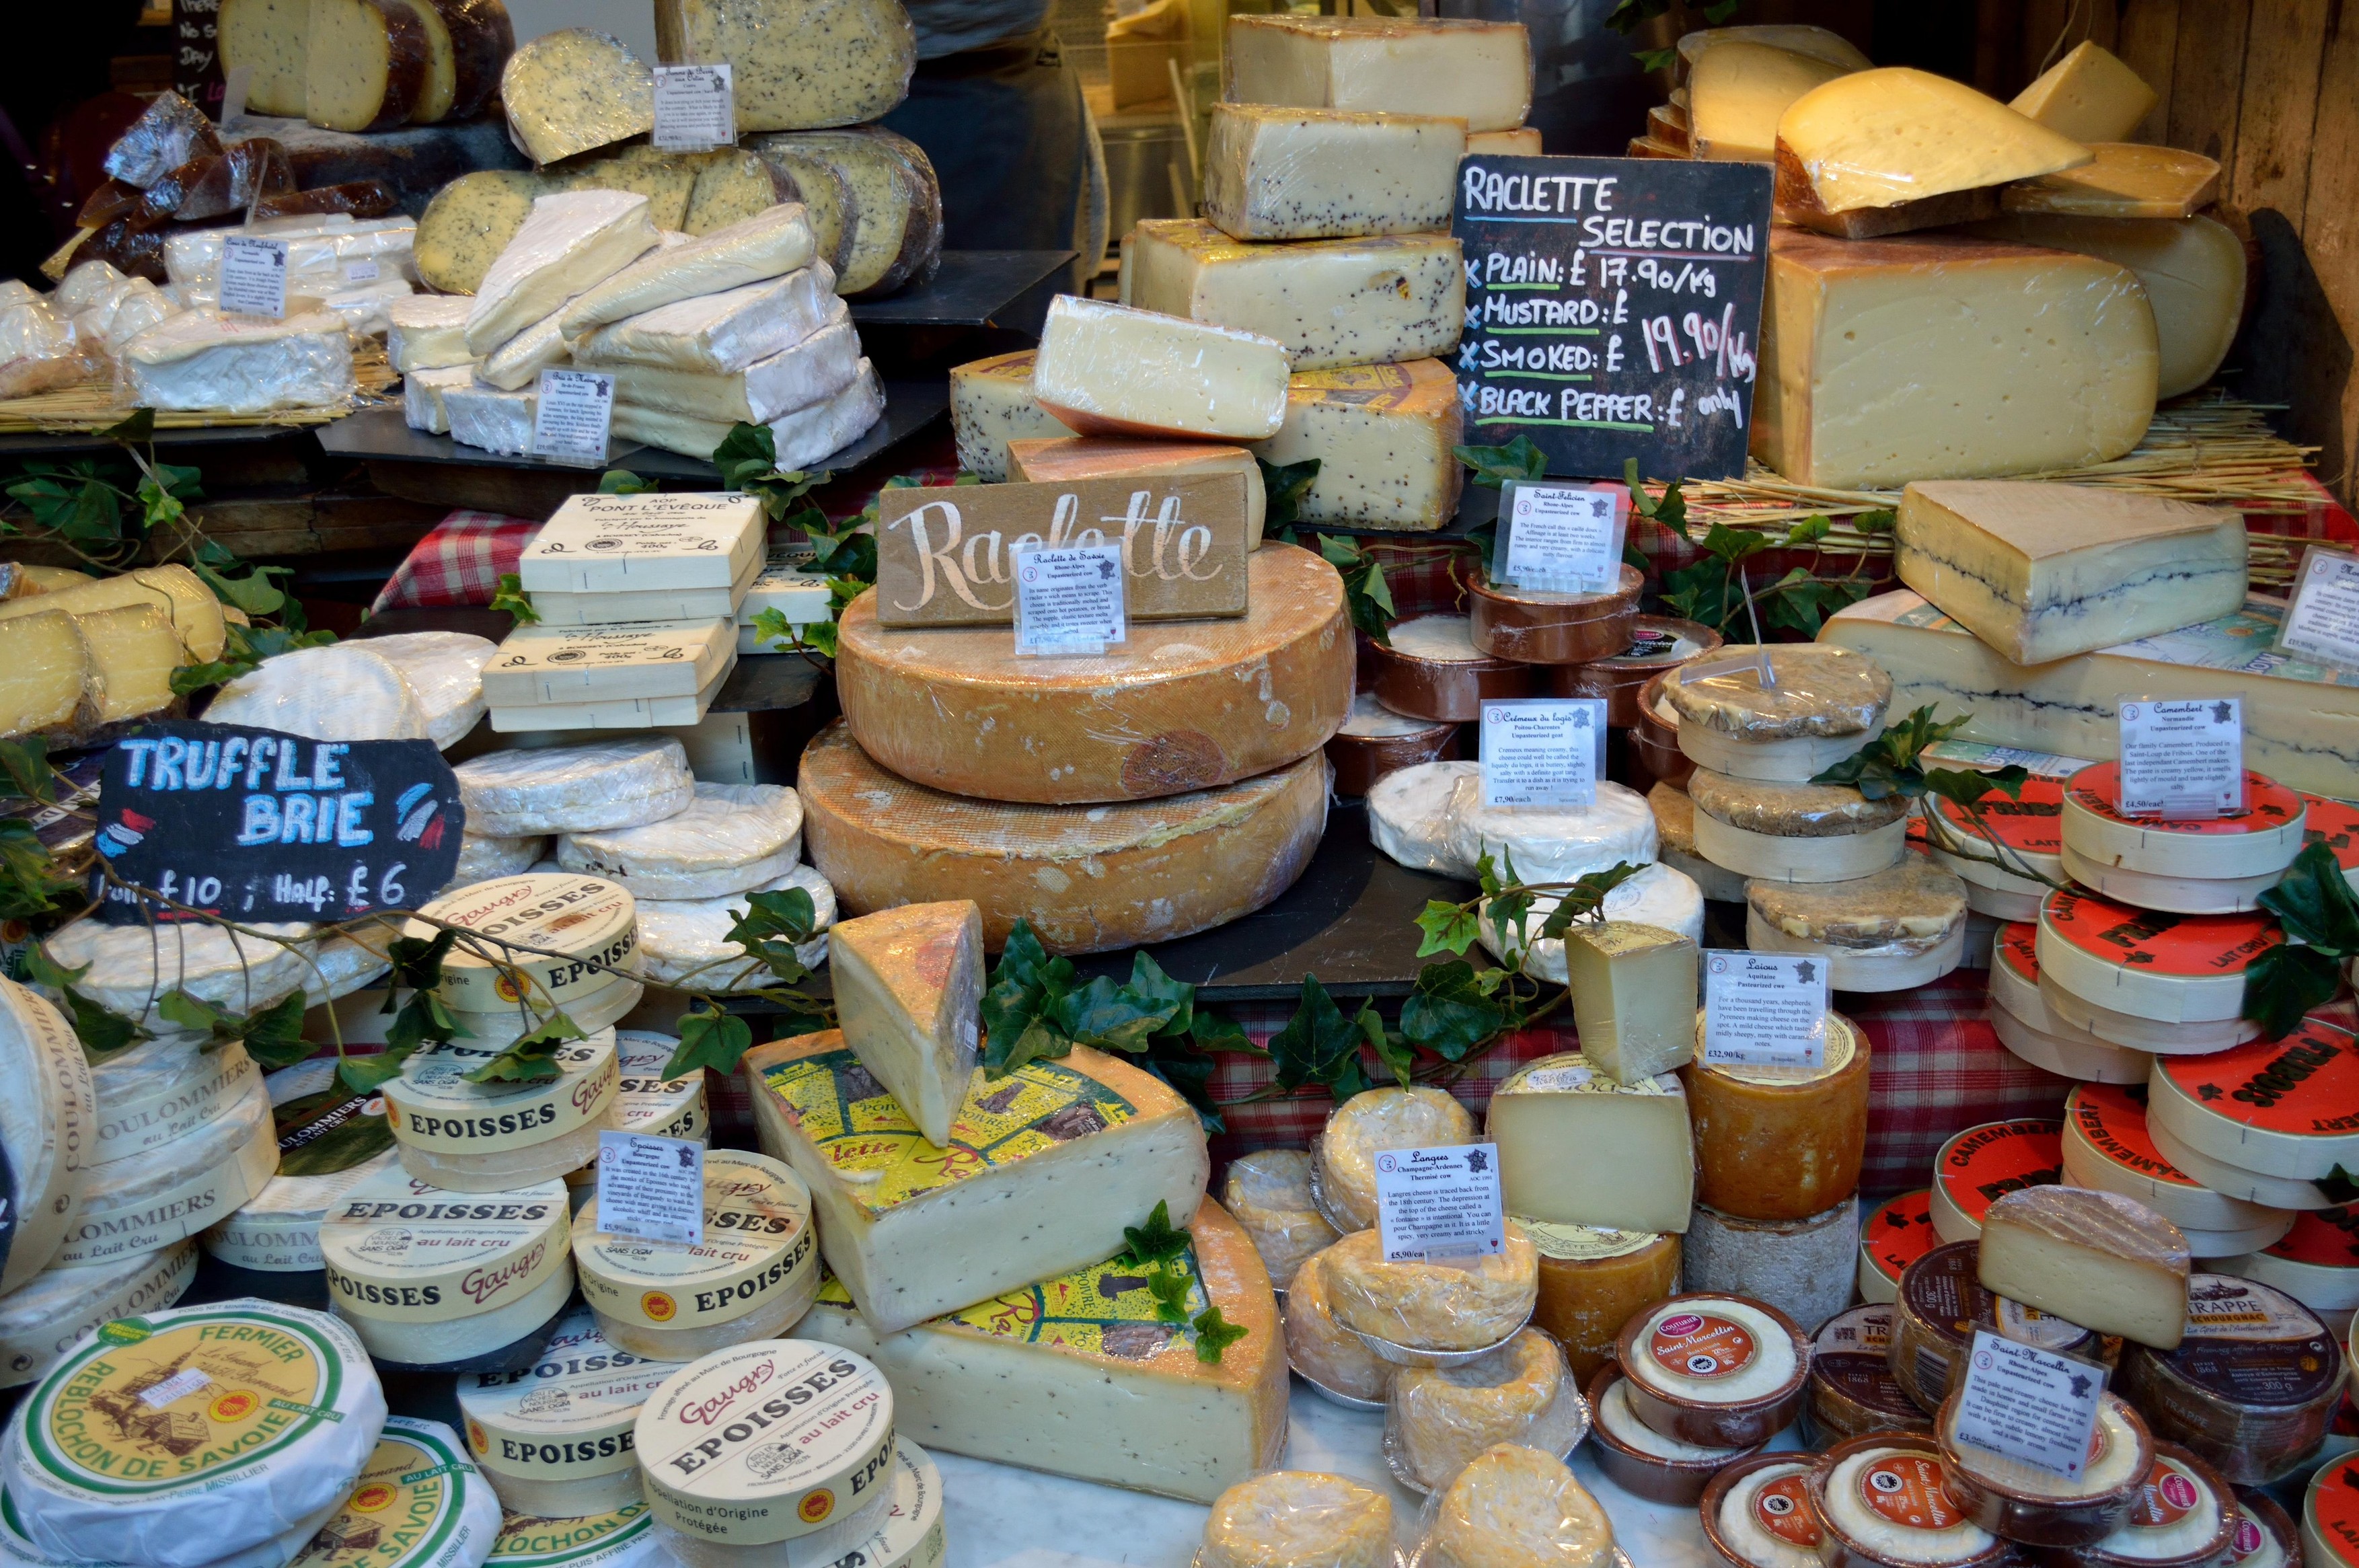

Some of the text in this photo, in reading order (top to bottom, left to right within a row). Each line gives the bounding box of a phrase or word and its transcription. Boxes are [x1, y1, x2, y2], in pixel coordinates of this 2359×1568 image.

[1464, 166, 1618, 213] RACLETTE
[1480, 388, 1550, 415] BLACK
[1698, 387, 1742, 428] only
[1034, 554, 1066, 564] Raclette
[1080, 550, 1105, 560] Savoie
[1552, 713, 1572, 724] logis
[2154, 702, 2203, 714] Camembert
[119, 735, 350, 792] TRUFFLE
[237, 790, 376, 848] BRIE
[1746, 959, 1778, 971] Laious
[1782, 999, 1811, 1007] shepherds
[295, 1116, 348, 1148] AU LAIT CRU
[409, 1103, 557, 1138] EPOISSES
[630, 1137, 663, 1152] Epoisses
[633, 1152, 660, 1160] Bourgogne
[622, 1159, 659, 1168] Unpasteurized
[1397, 1164, 1463, 1173] Champagne-Ardennes
[1411, 1151, 1449, 1165] Langres
[341, 1203, 549, 1221] EPOISSES
[416, 1237, 511, 1248] au lait cru
[687, 1246, 751, 1262] lait cru
[63, 1251, 85, 1262] au
[695, 1230, 811, 1312] EPOISSES
[1660, 1316, 1698, 1331] COUTURIER
[199, 1325, 305, 1364] FERMIER
[1657, 1325, 1734, 1355] Saint-Marcellin
[1990, 1338, 2070, 1374] Saint-Marcellin
[2009, 1359, 2048, 1376] Rhone-Alpes
[1997, 1366, 2055, 1389] Unpasteurized cow
[55, 1361, 292, 1478] REBLOCHON DE SAVOIE
[272, 1398, 341, 1420] AU LAIT CRU
[670, 1359, 857, 1475] EPOISSES
[780, 1415, 817, 1440] Appellation
[845, 1378, 875, 1398] Protégée
[799, 1392, 880, 1444] au lait cru
[204, 1462, 269, 1493] MISSILLIER
[649, 1479, 703, 1516] Appellation
[1915, 1460, 1946, 1526] Saint-Marcellin
[2173, 1476, 2191, 1508] COUTURIER
[675, 1511, 728, 1534] Protégée
